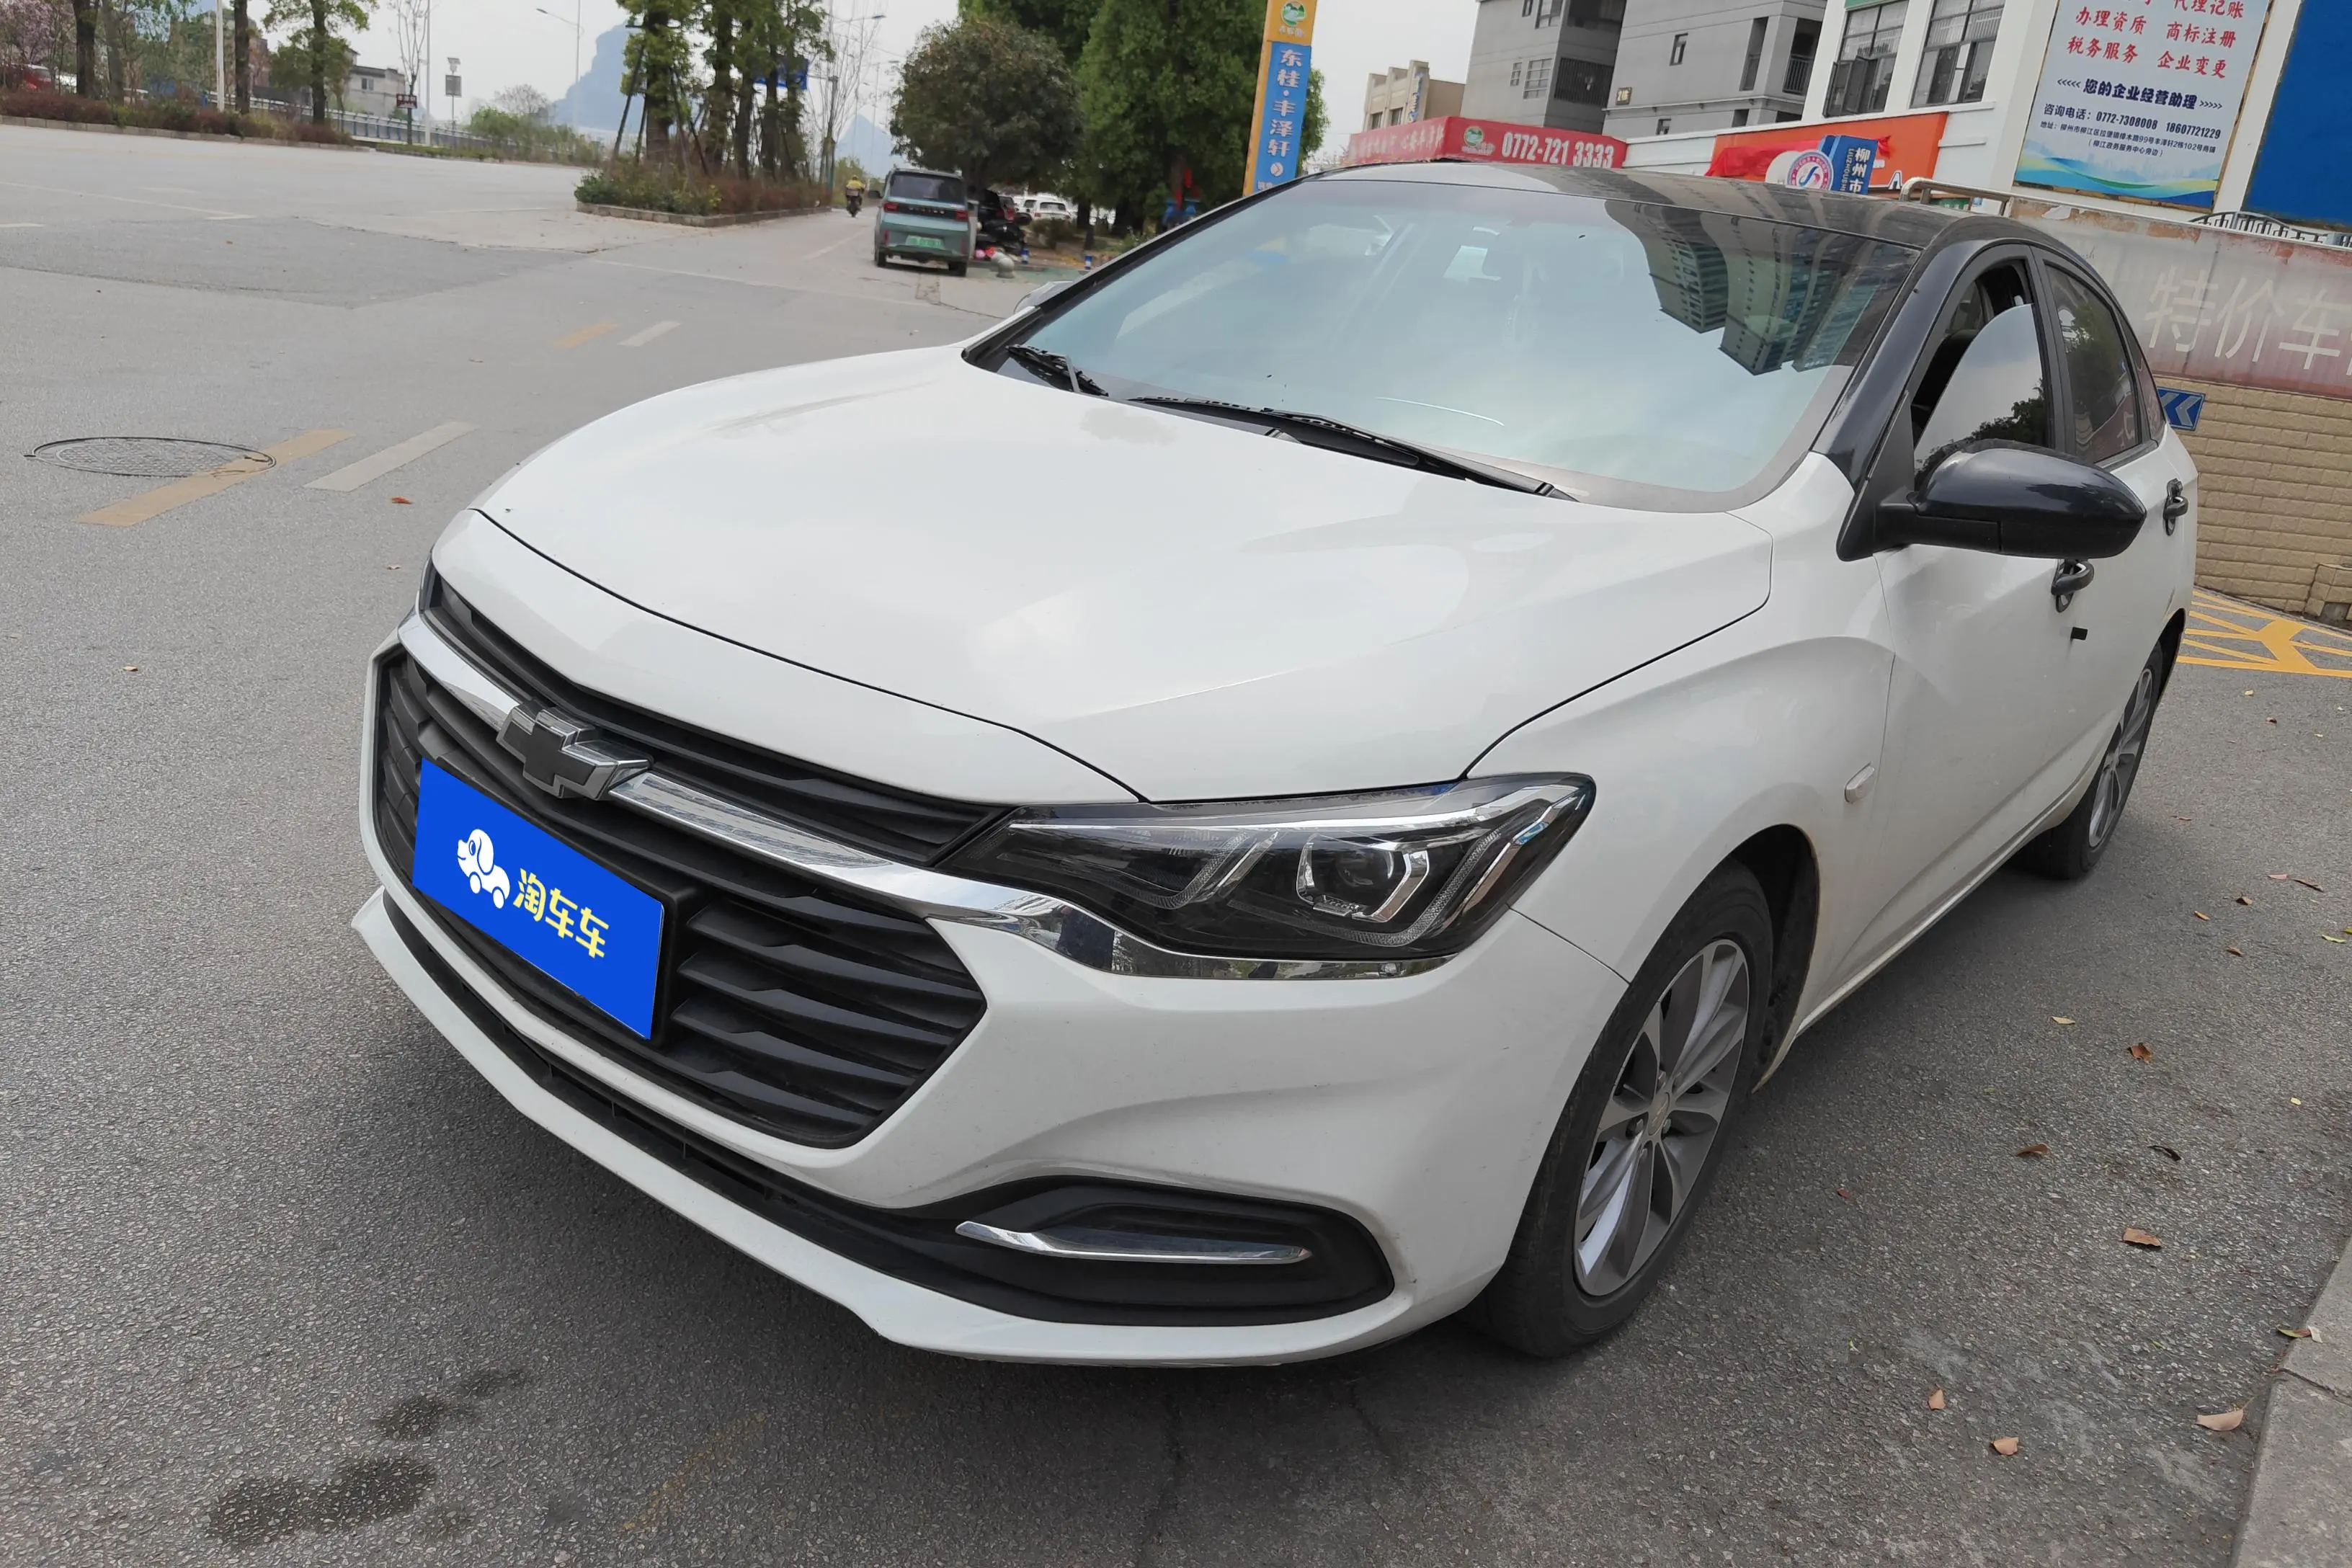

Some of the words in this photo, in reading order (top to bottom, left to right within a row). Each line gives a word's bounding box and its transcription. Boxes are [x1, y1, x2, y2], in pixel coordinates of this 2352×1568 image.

[2075, 6, 2147, 35] 办理资质
[2166, 21, 2237, 48] 商标注册
[2067, 35, 2139, 63] 税务服务
[2157, 50, 2227, 79] 企业变更
[2083, 78, 2198, 110] 您的企业经营助理
[2165, 121, 2222, 140] 18607721229
[1849, 147, 1871, 193] 柳州市
